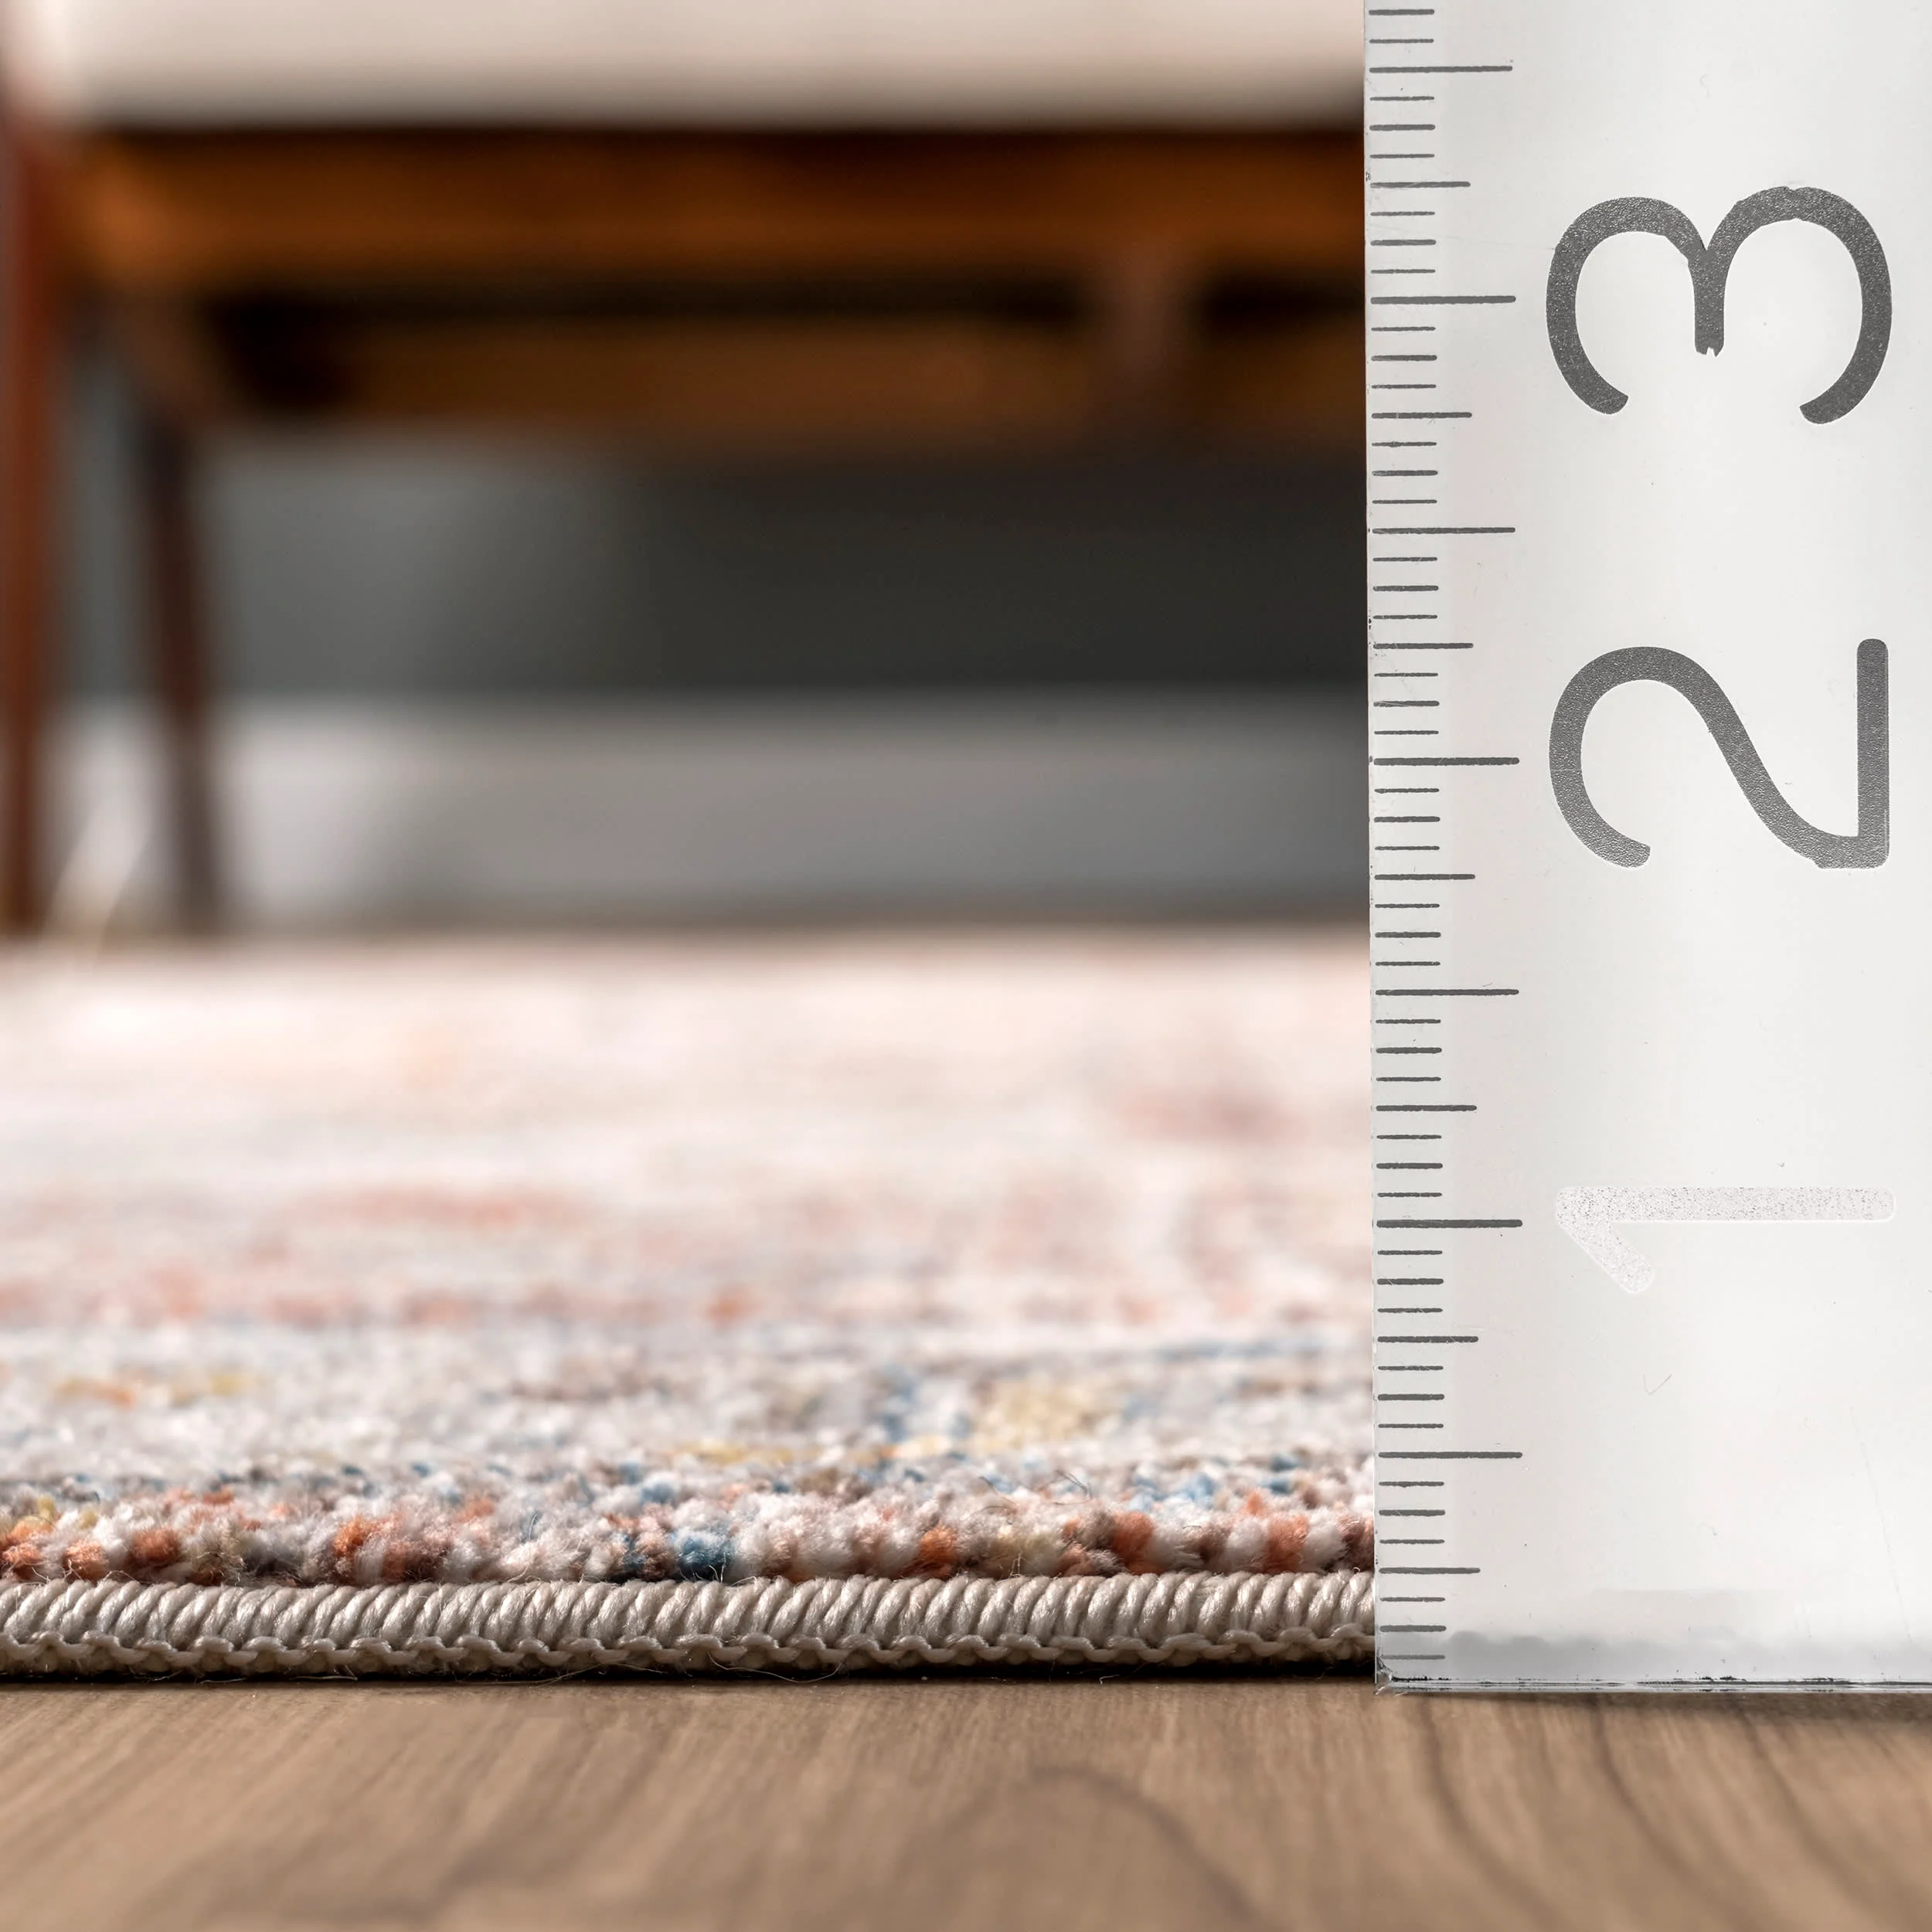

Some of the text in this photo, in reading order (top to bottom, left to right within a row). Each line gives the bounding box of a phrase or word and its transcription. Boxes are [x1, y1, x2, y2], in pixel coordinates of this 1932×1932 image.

[1546, 185, 1893, 424] 3
[1549, 638, 1890, 869] 2
[1555, 1185, 1896, 1294] 1
